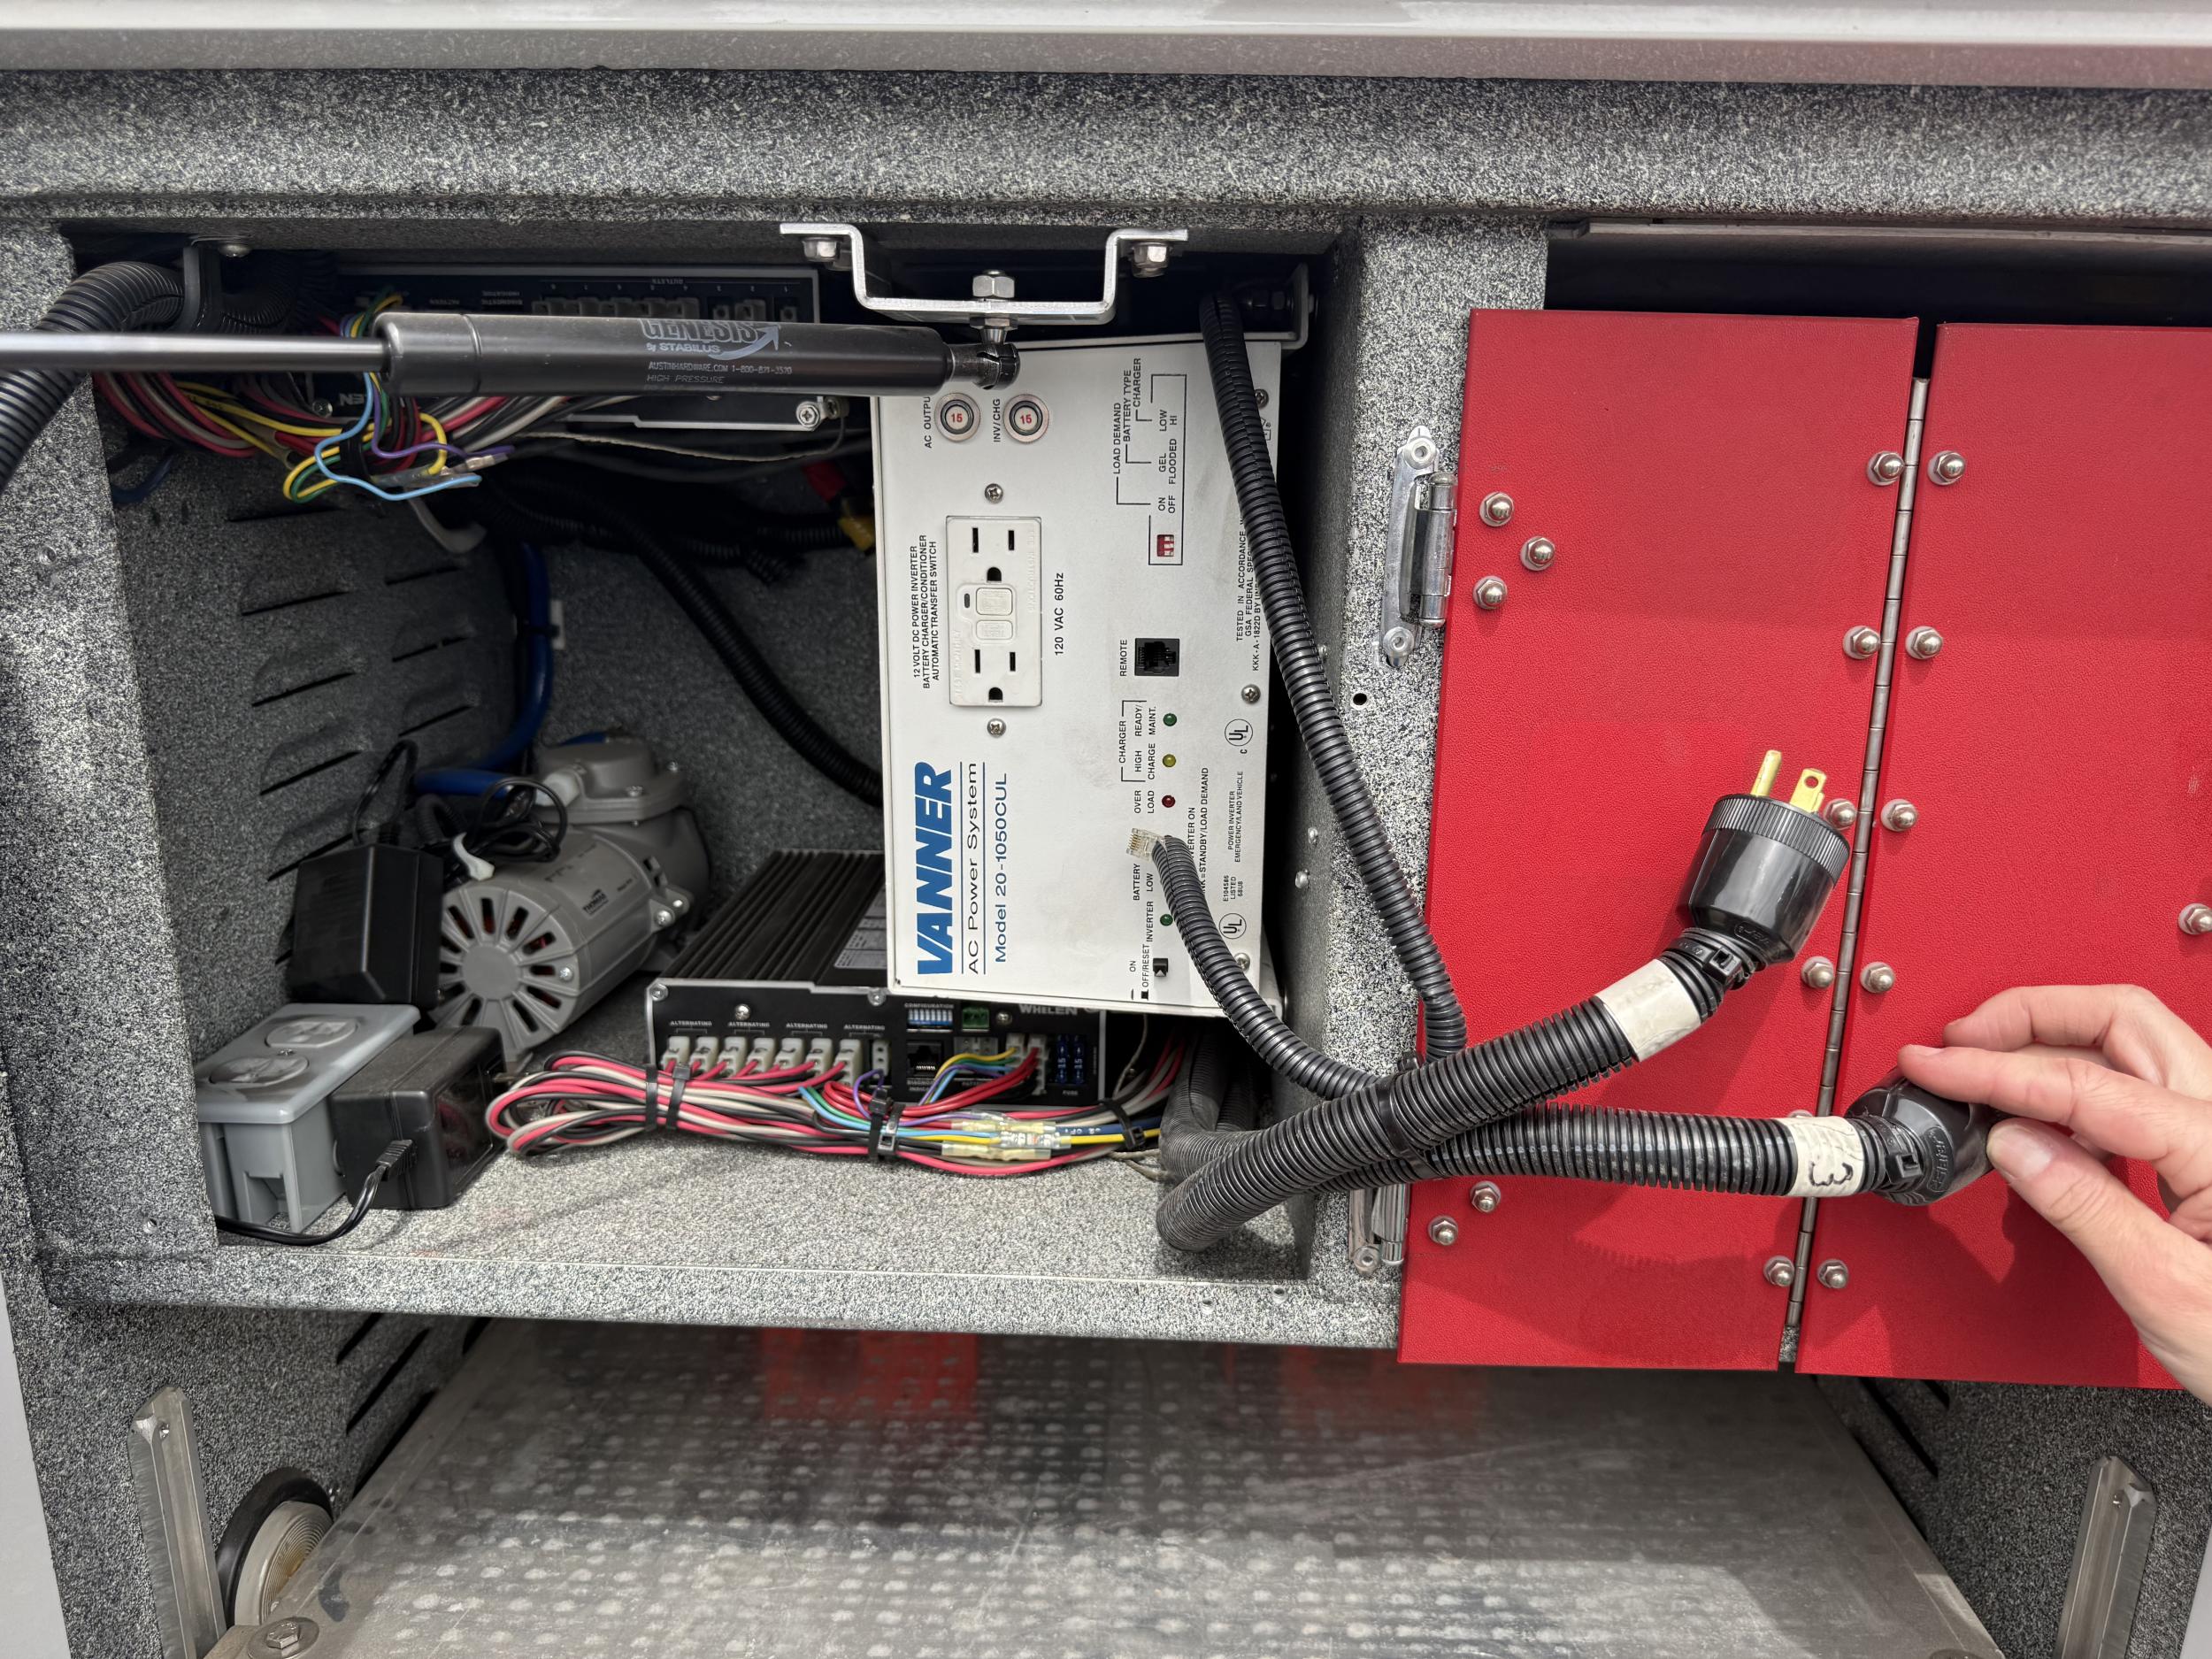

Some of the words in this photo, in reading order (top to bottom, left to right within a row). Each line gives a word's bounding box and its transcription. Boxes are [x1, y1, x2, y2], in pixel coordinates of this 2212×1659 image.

[641, 318, 759, 343] GENESIS
[659, 342, 721, 353] STABILUS
[675, 374, 726, 384] PRESSURE
[951, 413, 963, 423] 15
[1020, 414, 1032, 424] 15
[1170, 416, 1177, 425] HI
[925, 435, 932, 449] AC
[1158, 497, 1166, 511] ON
[920, 535, 929, 646] CHARGER/CONDITIONER
[1055, 573, 1064, 601] 60Hz
[1255, 603, 1261, 613] BY
[1055, 608, 1064, 630] VAC
[913, 630, 919, 641] DC
[1055, 637, 1064, 656] 120
[913, 669, 920, 678] 12
[967, 764, 979, 849] System
[1188, 808, 1194, 819] ON
[995, 773, 1007, 896] 20-1050CUL
[915, 762, 952, 974] VANNER
[968, 858, 978, 930] Power
[995, 904, 1006, 962] Model
[968, 941, 979, 974] AC
[1130, 961, 1136, 972] ON
[1018, 1003, 1078, 1016] WHELEN
